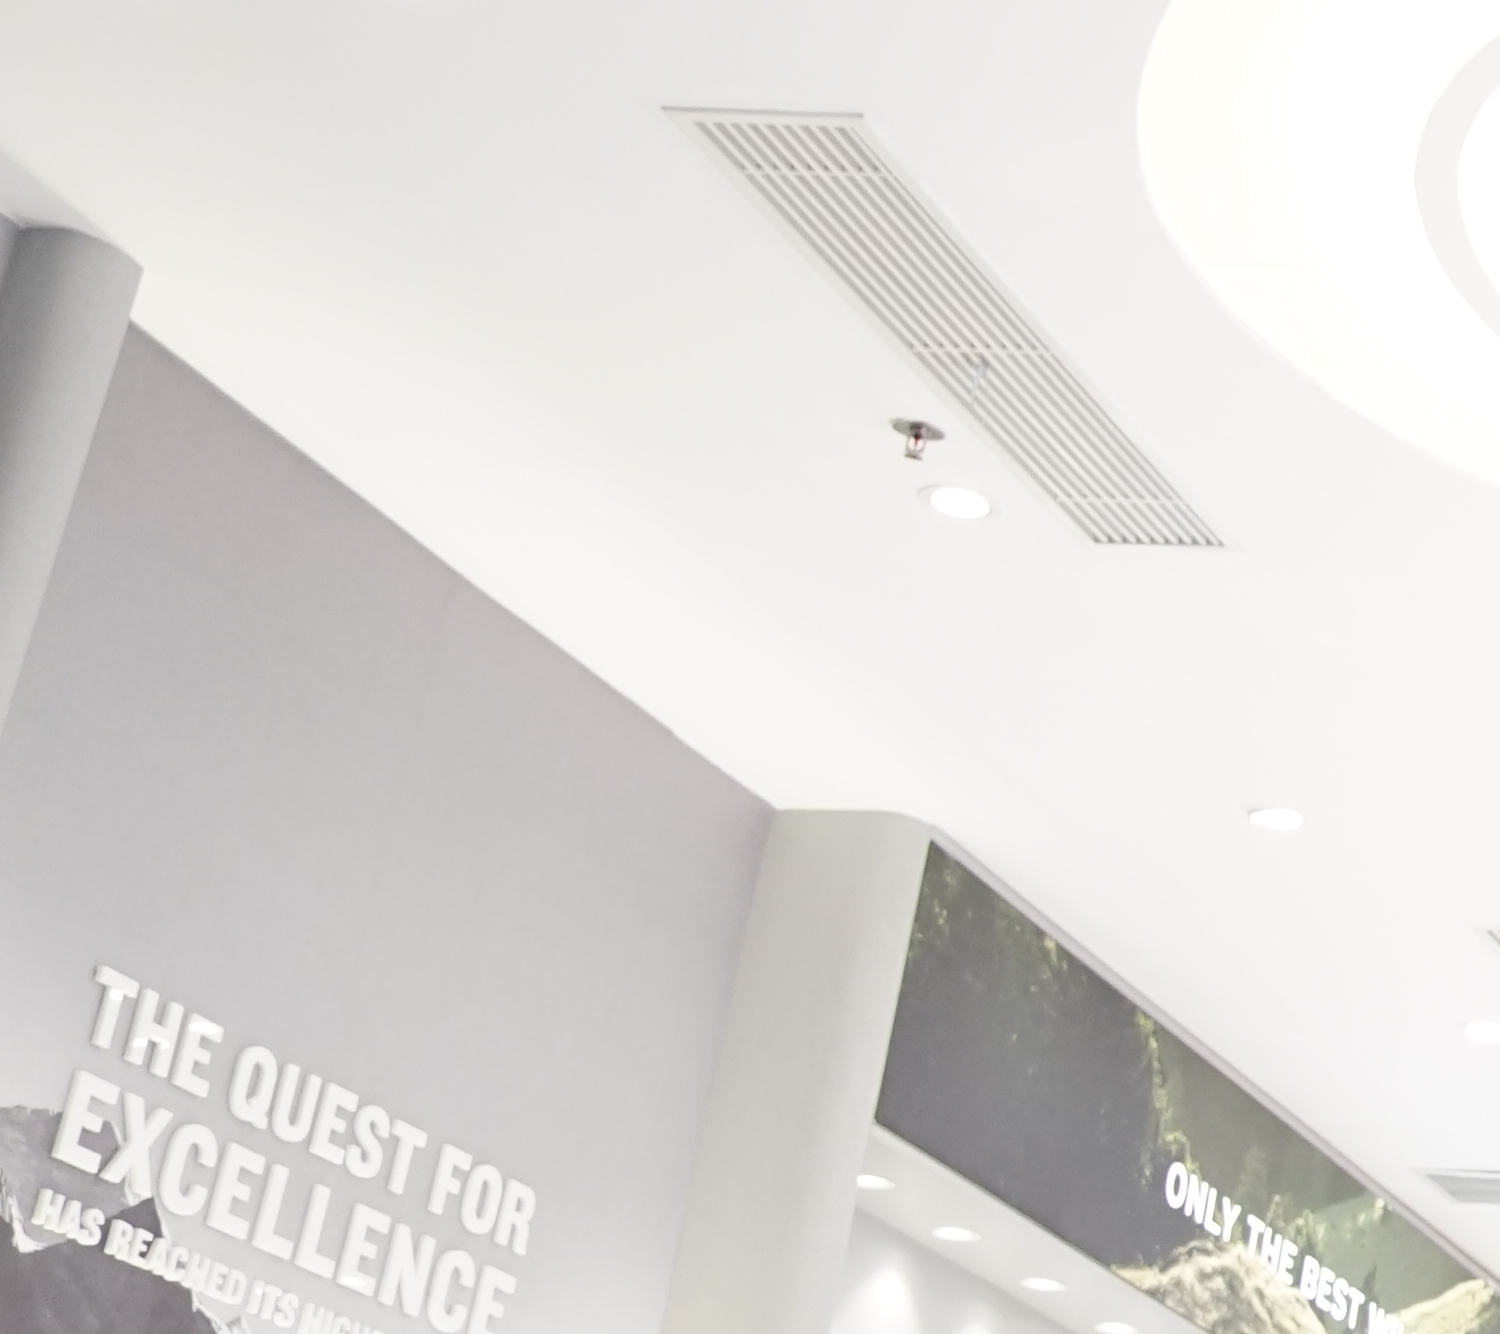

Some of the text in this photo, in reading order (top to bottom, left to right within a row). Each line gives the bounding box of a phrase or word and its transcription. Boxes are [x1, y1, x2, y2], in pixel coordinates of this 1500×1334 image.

[91, 964, 536, 1256] THE QUEST FOR
[31, 1187, 106, 1246] HAS
[103, 1218, 248, 1305] REACHED
[246, 1279, 299, 1329] ITS
[1165, 1161, 1242, 1243] ONLY
[1246, 1214, 1299, 1287] THE
[1299, 1255, 1366, 1330] BEST
